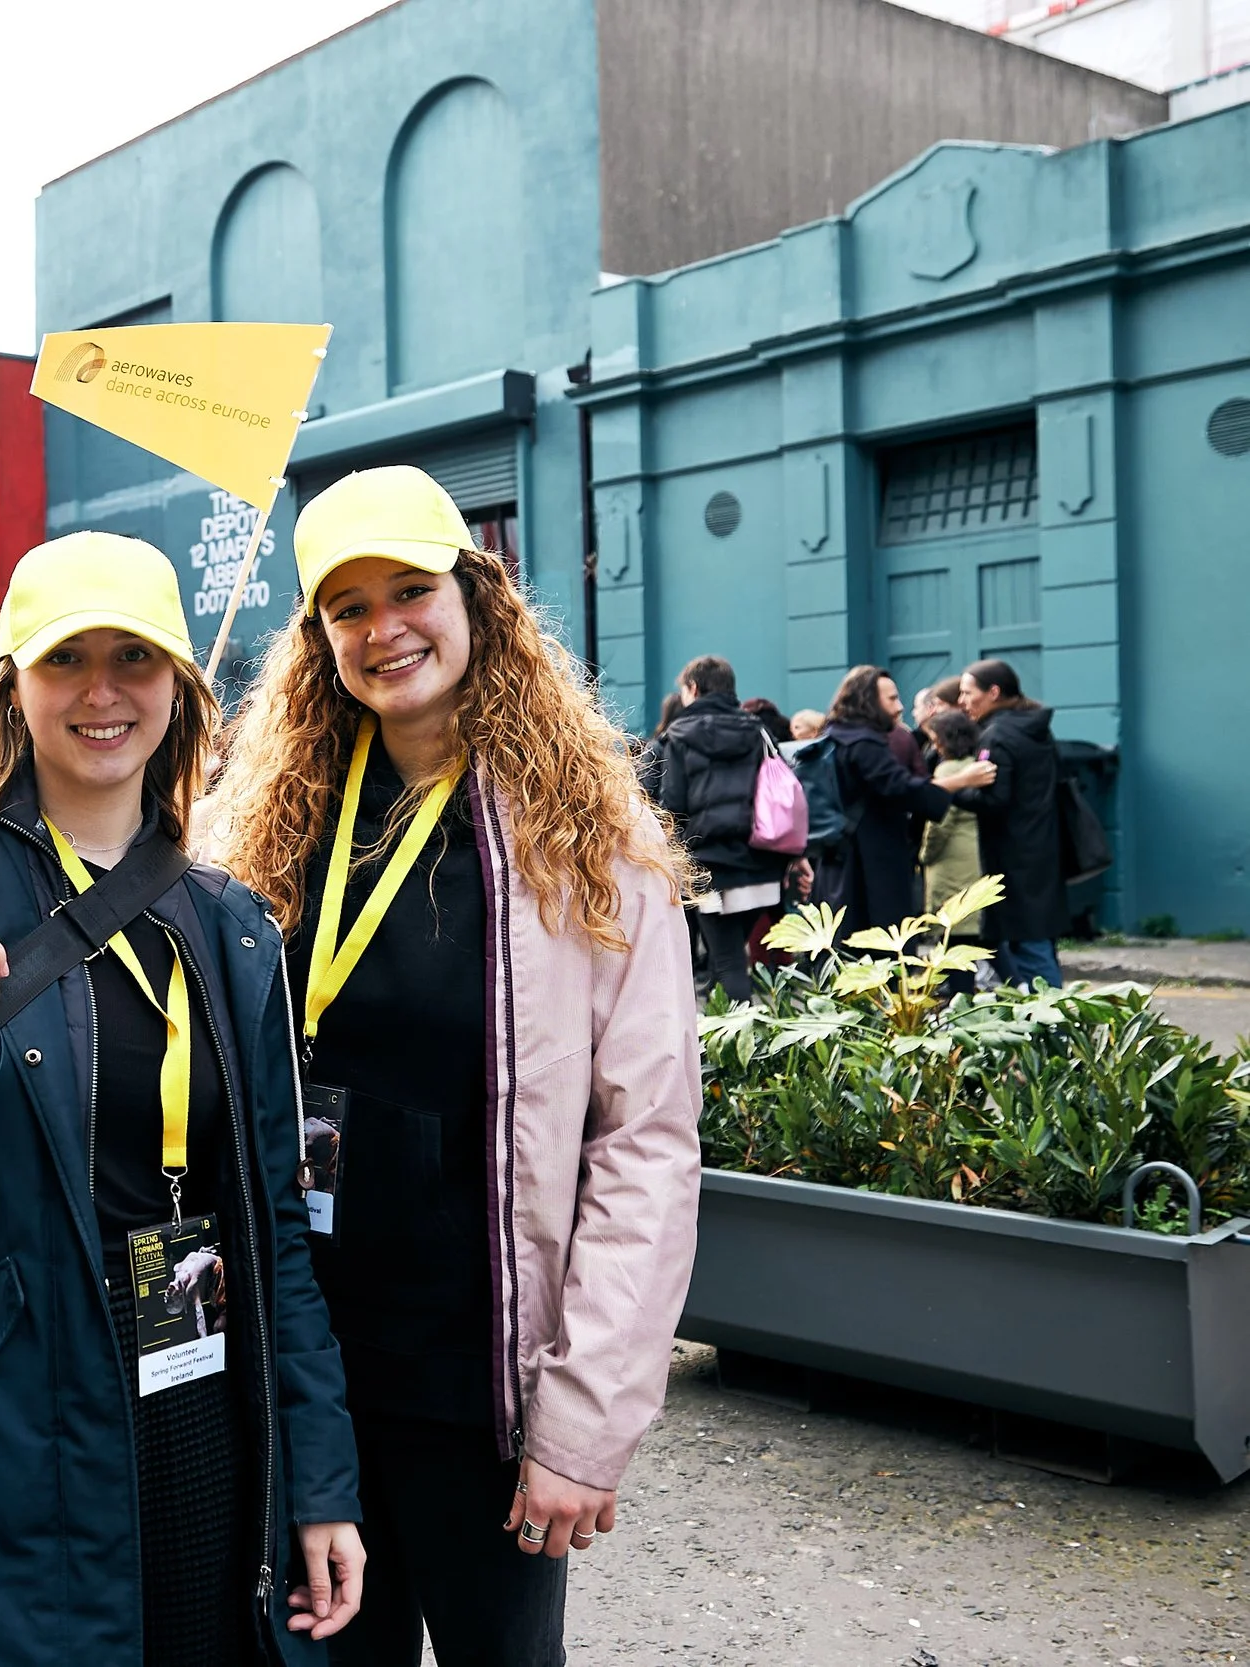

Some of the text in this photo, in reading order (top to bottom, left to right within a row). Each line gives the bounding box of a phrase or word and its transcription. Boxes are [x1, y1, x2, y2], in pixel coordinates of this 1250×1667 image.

[111, 360, 193, 387] aerowaves
[106, 377, 270, 428] dance across europe
[201, 509, 258, 542] DEPOT
[189, 543, 207, 569] 12
[201, 557, 261, 590] ABBY
[133, 1234, 159, 1247] SPRING
[134, 1242, 164, 1256] FORWARD
[135, 1251, 164, 1263] FESTIVAL
[151, 1352, 214, 1377] Spring Forward Festival
[166, 1347, 198, 1361] Volunteer
[171, 1369, 194, 1382] Ireland
